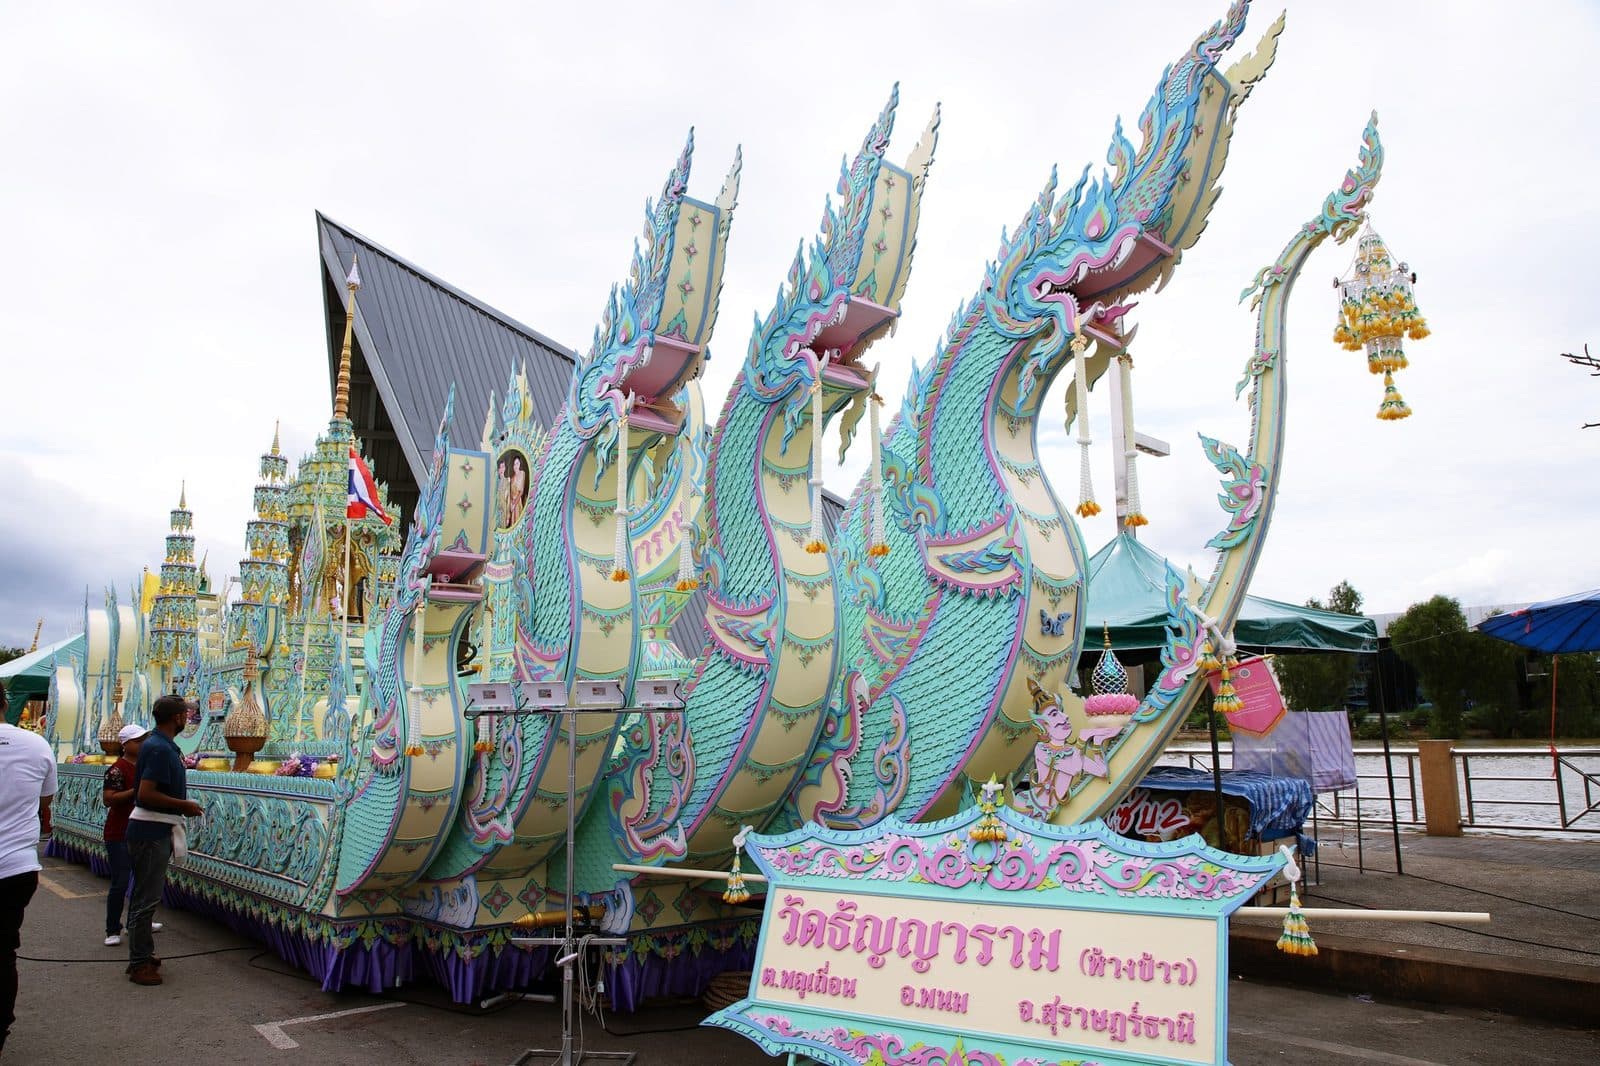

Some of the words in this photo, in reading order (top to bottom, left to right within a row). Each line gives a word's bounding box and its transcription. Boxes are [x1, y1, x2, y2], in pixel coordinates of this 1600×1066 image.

[777, 894, 1062, 973] วัดธัญญาราม
[900, 985, 969, 1014] อ.พนม
[1018, 995, 1196, 1044] จ.สุราษฎร์ธานี
